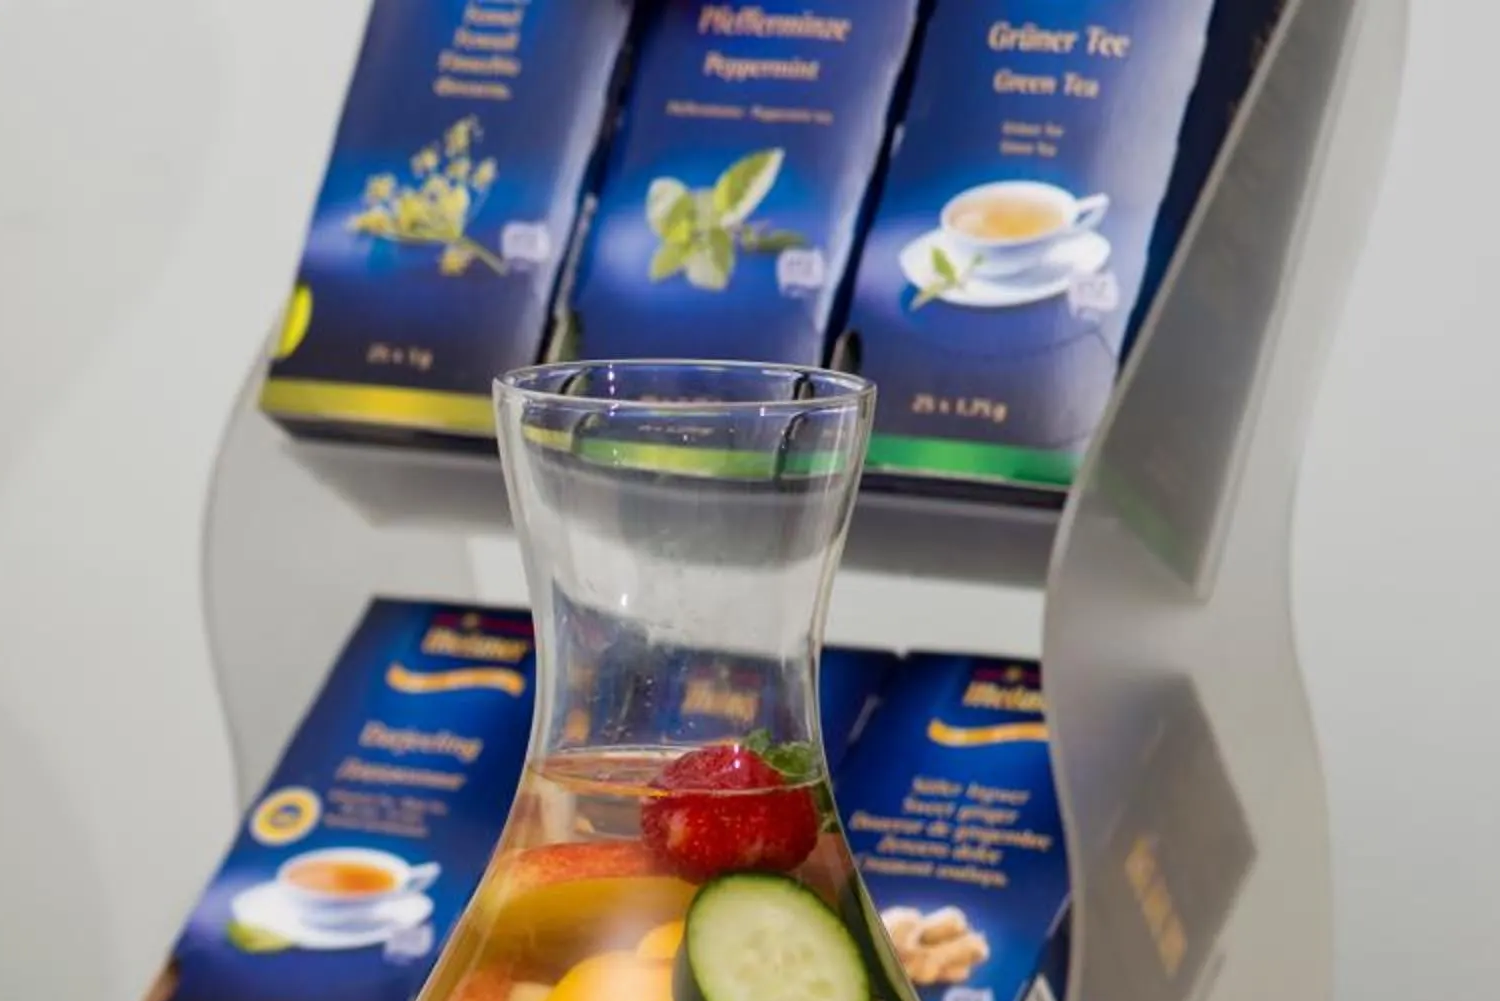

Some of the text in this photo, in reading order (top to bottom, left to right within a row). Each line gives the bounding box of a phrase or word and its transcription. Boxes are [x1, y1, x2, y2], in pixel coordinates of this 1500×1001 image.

[699, 6, 851, 41] Pfefferminze
[989, 21, 1131, 57] Grüner Tee
[704, 51, 820, 82] Peppermint
[994, 68, 1098, 98] Green Tea
[912, 395, 934, 413] 25
[359, 720, 483, 763] Darjeeling
